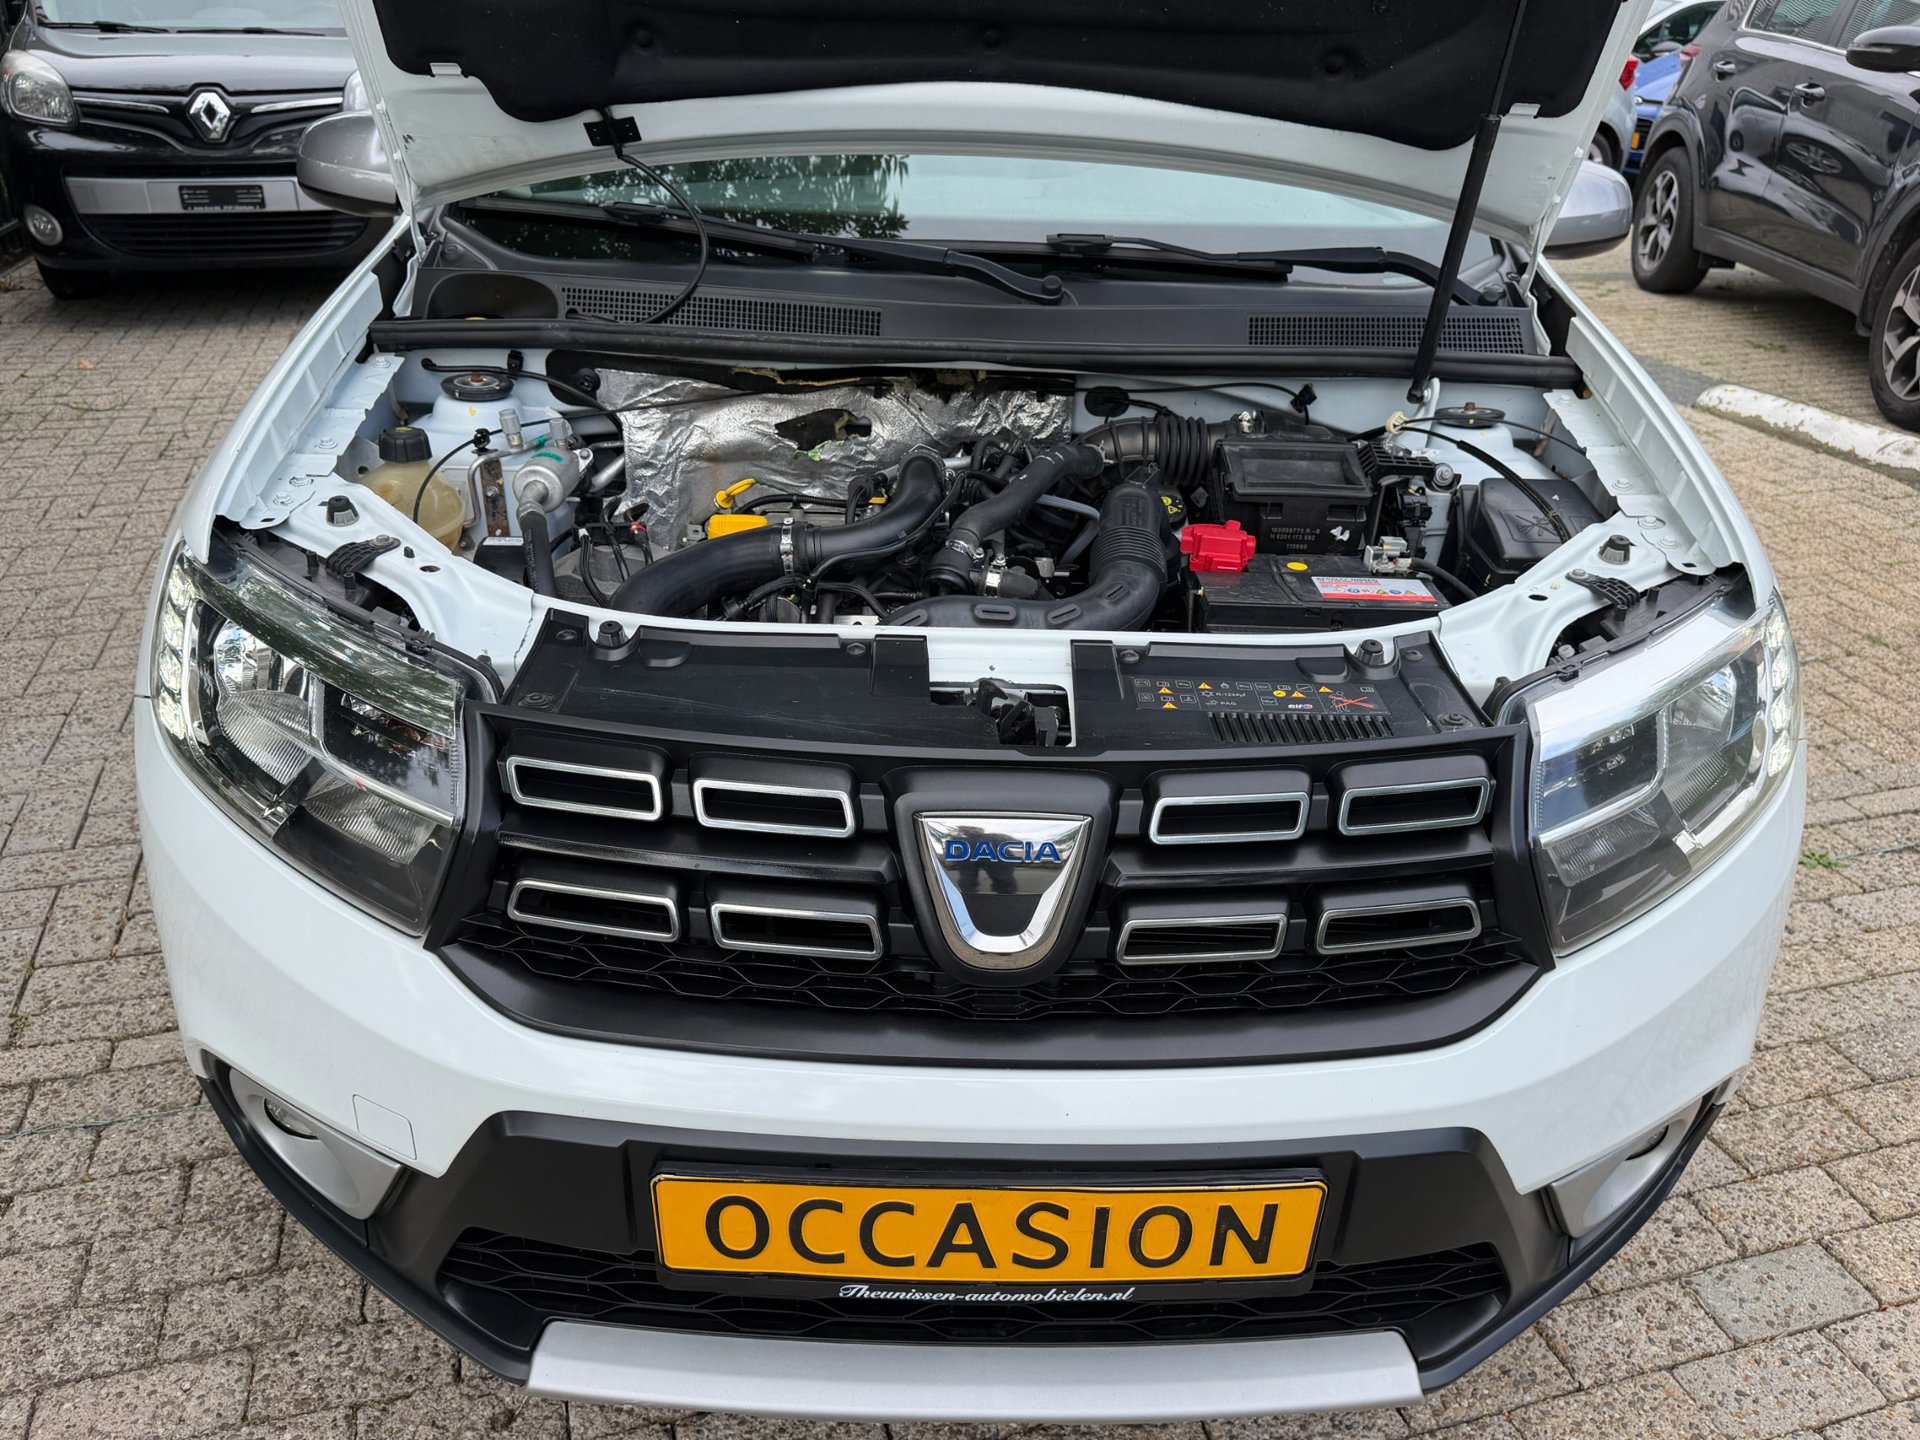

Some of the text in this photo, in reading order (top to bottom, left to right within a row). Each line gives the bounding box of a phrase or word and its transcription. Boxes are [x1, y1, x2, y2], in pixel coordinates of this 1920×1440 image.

[945, 840, 1061, 863] DACIA
[705, 1195, 1279, 1269] OCCASION
[838, 1284, 1136, 1302] Theunissen-automobielen.nl
